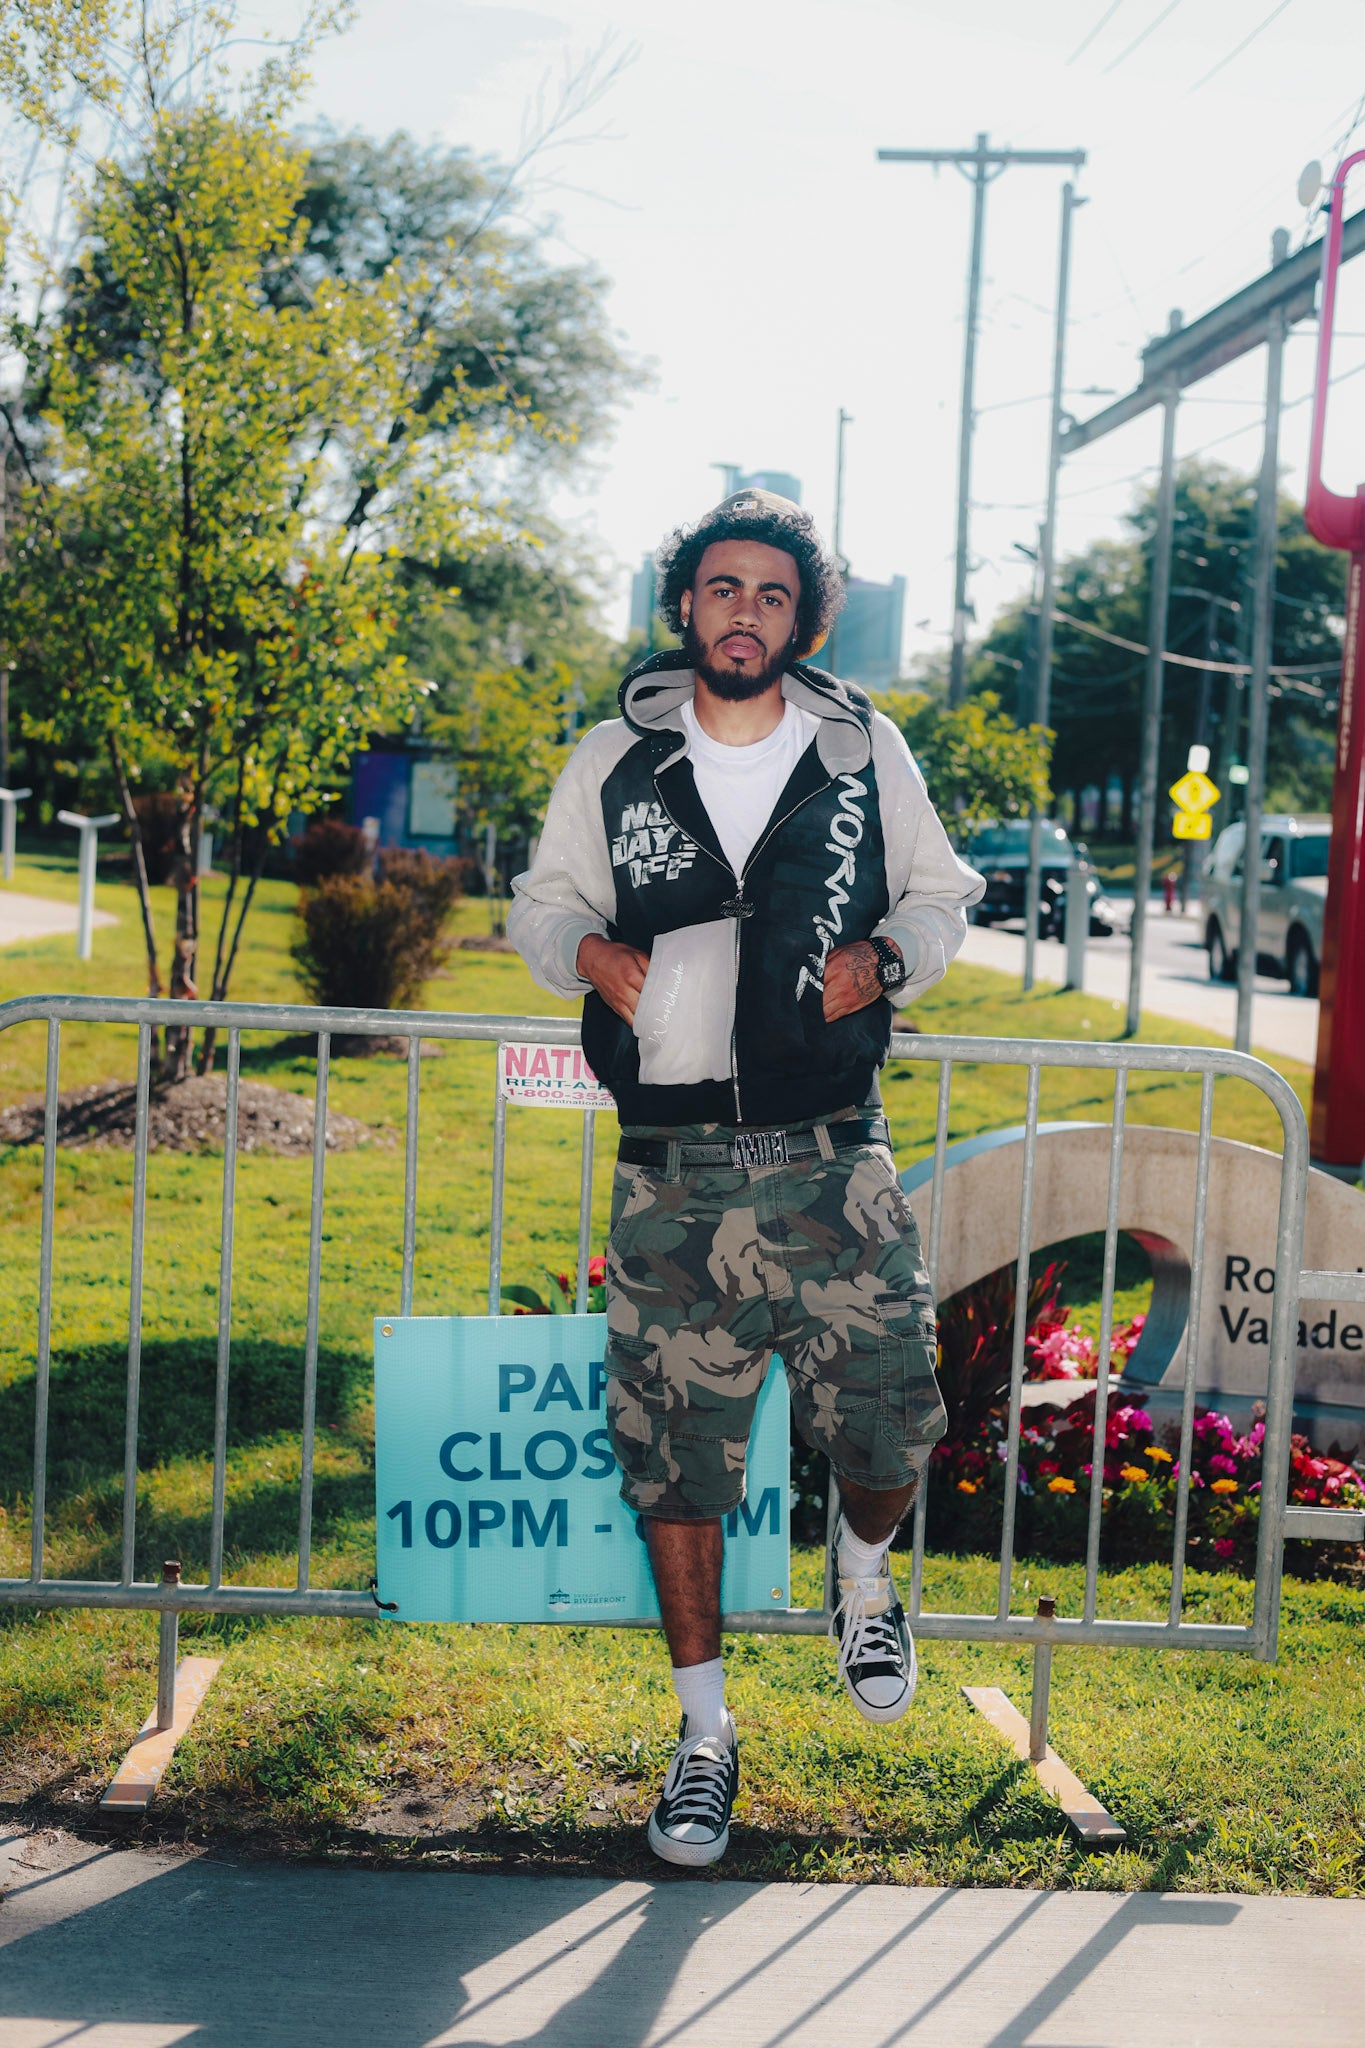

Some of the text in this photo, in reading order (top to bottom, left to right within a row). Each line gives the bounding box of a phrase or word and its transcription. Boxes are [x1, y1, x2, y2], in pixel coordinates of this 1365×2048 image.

[628, 851, 697, 889] OFF
[648, 960, 685, 1049] Worldwide
[733, 1130, 790, 1169] AMIRI
[1219, 1304, 1364, 1351] Vade
[386, 1498, 569, 1550] 10PM
[573, 1595, 627, 1604] RIVERFRONT
